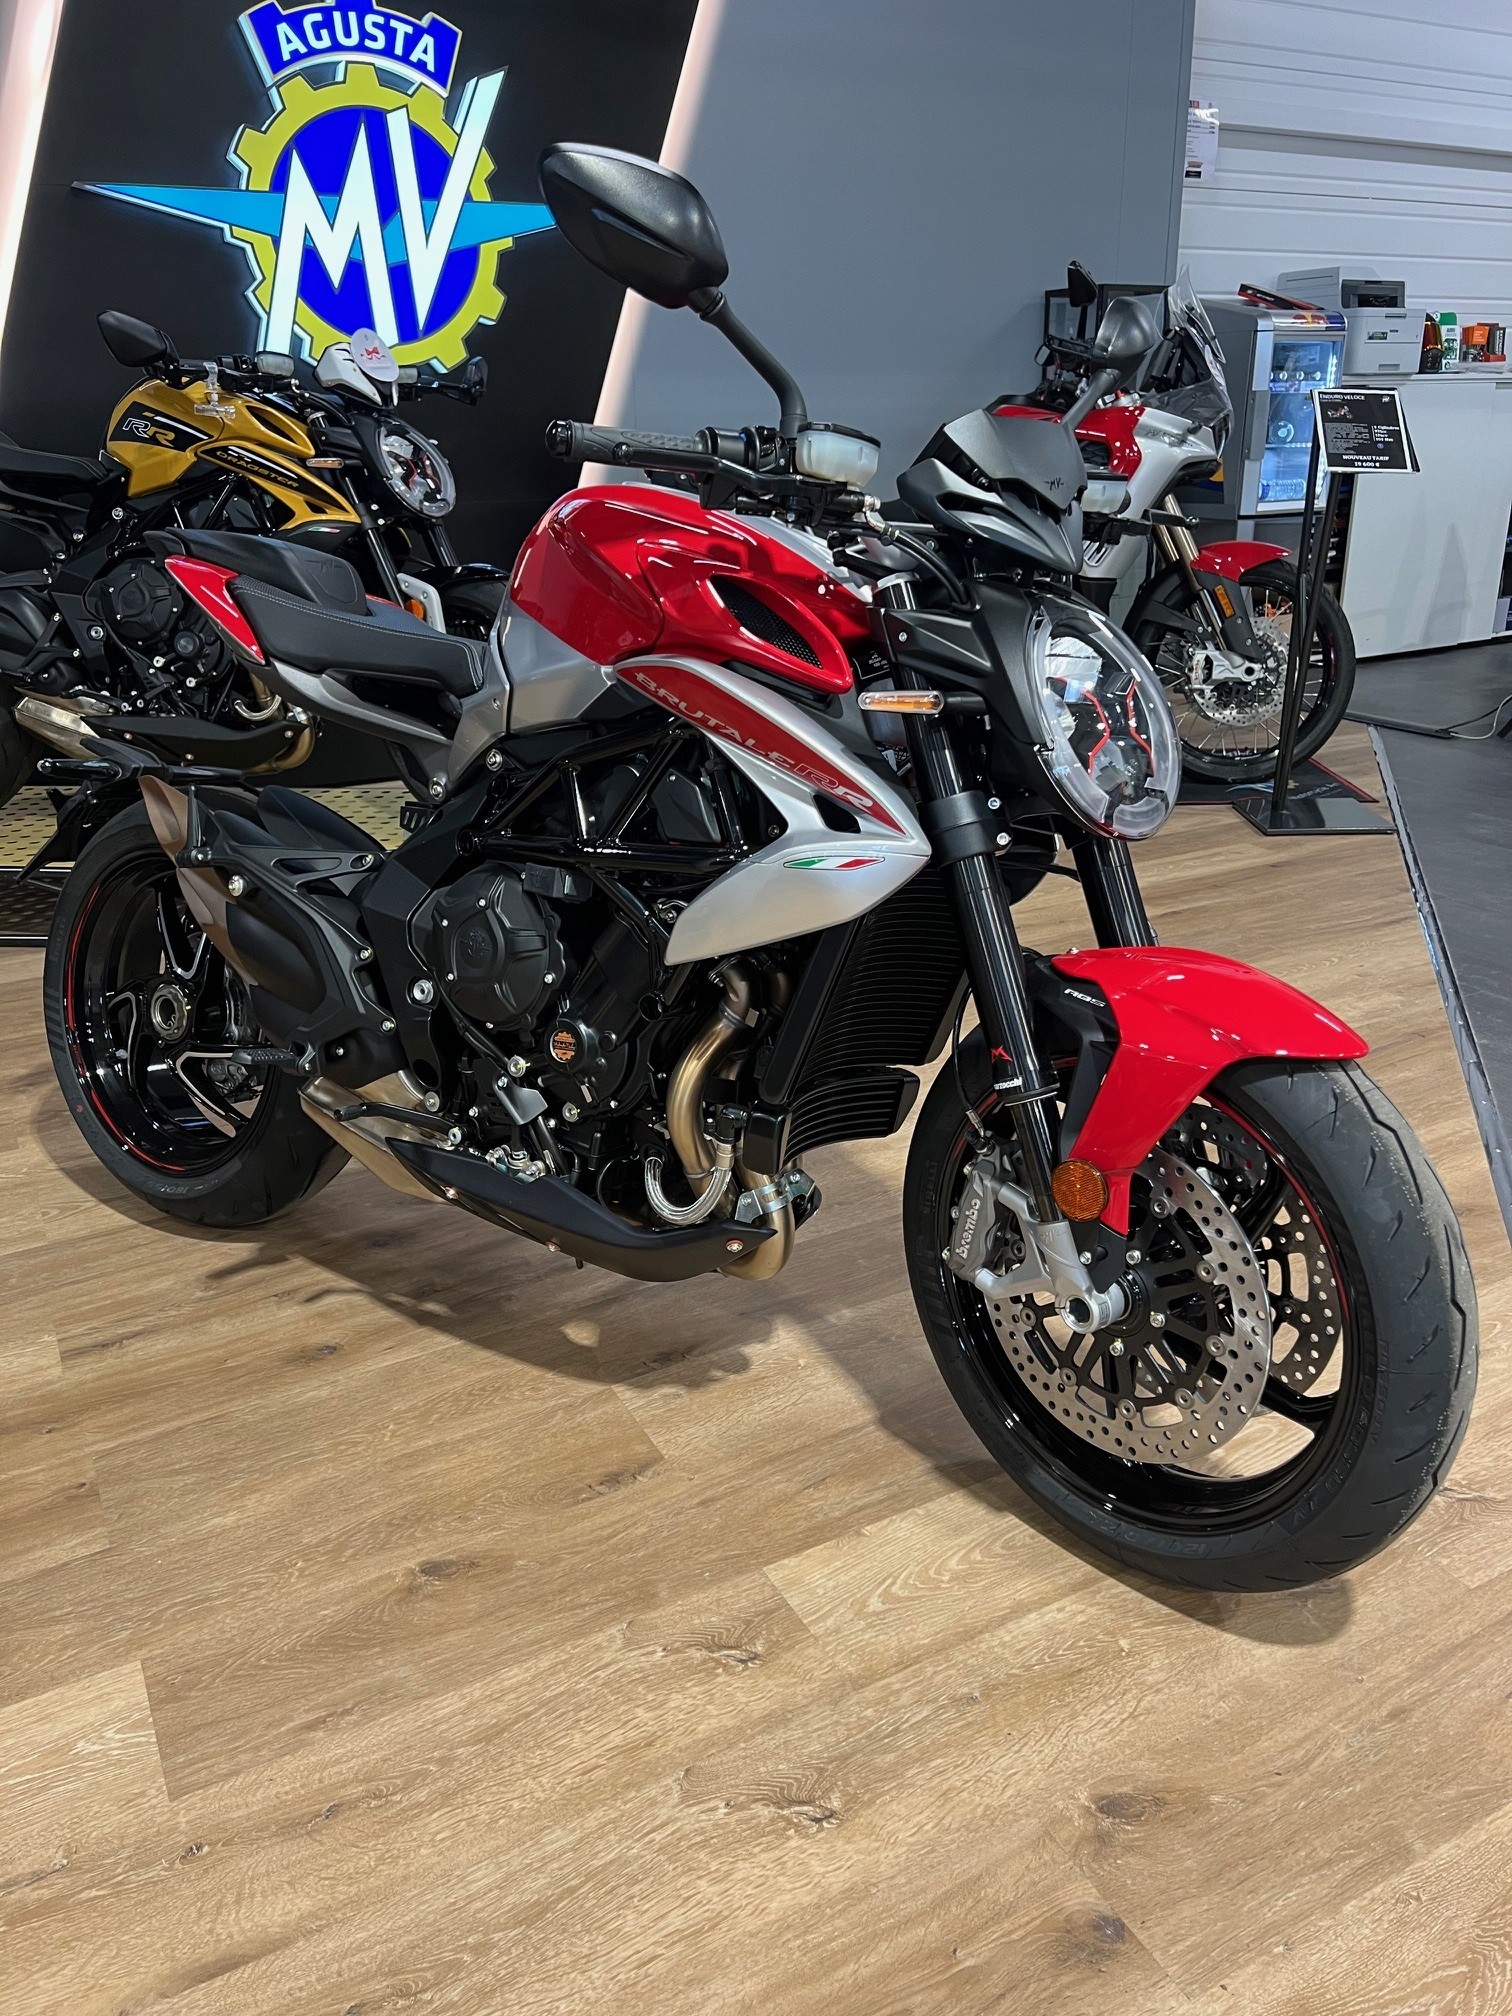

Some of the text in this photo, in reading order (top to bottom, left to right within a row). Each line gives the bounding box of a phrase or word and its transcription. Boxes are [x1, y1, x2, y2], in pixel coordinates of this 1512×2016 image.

[276, 11, 435, 73] AGUSTA
[265, 69, 506, 354] MV
[122, 418, 176, 447] RR
[216, 451, 299, 488] DRAGSTER
[634, 672, 874, 815] BRUTALE RR
[955, 1198, 981, 1260] brembo
